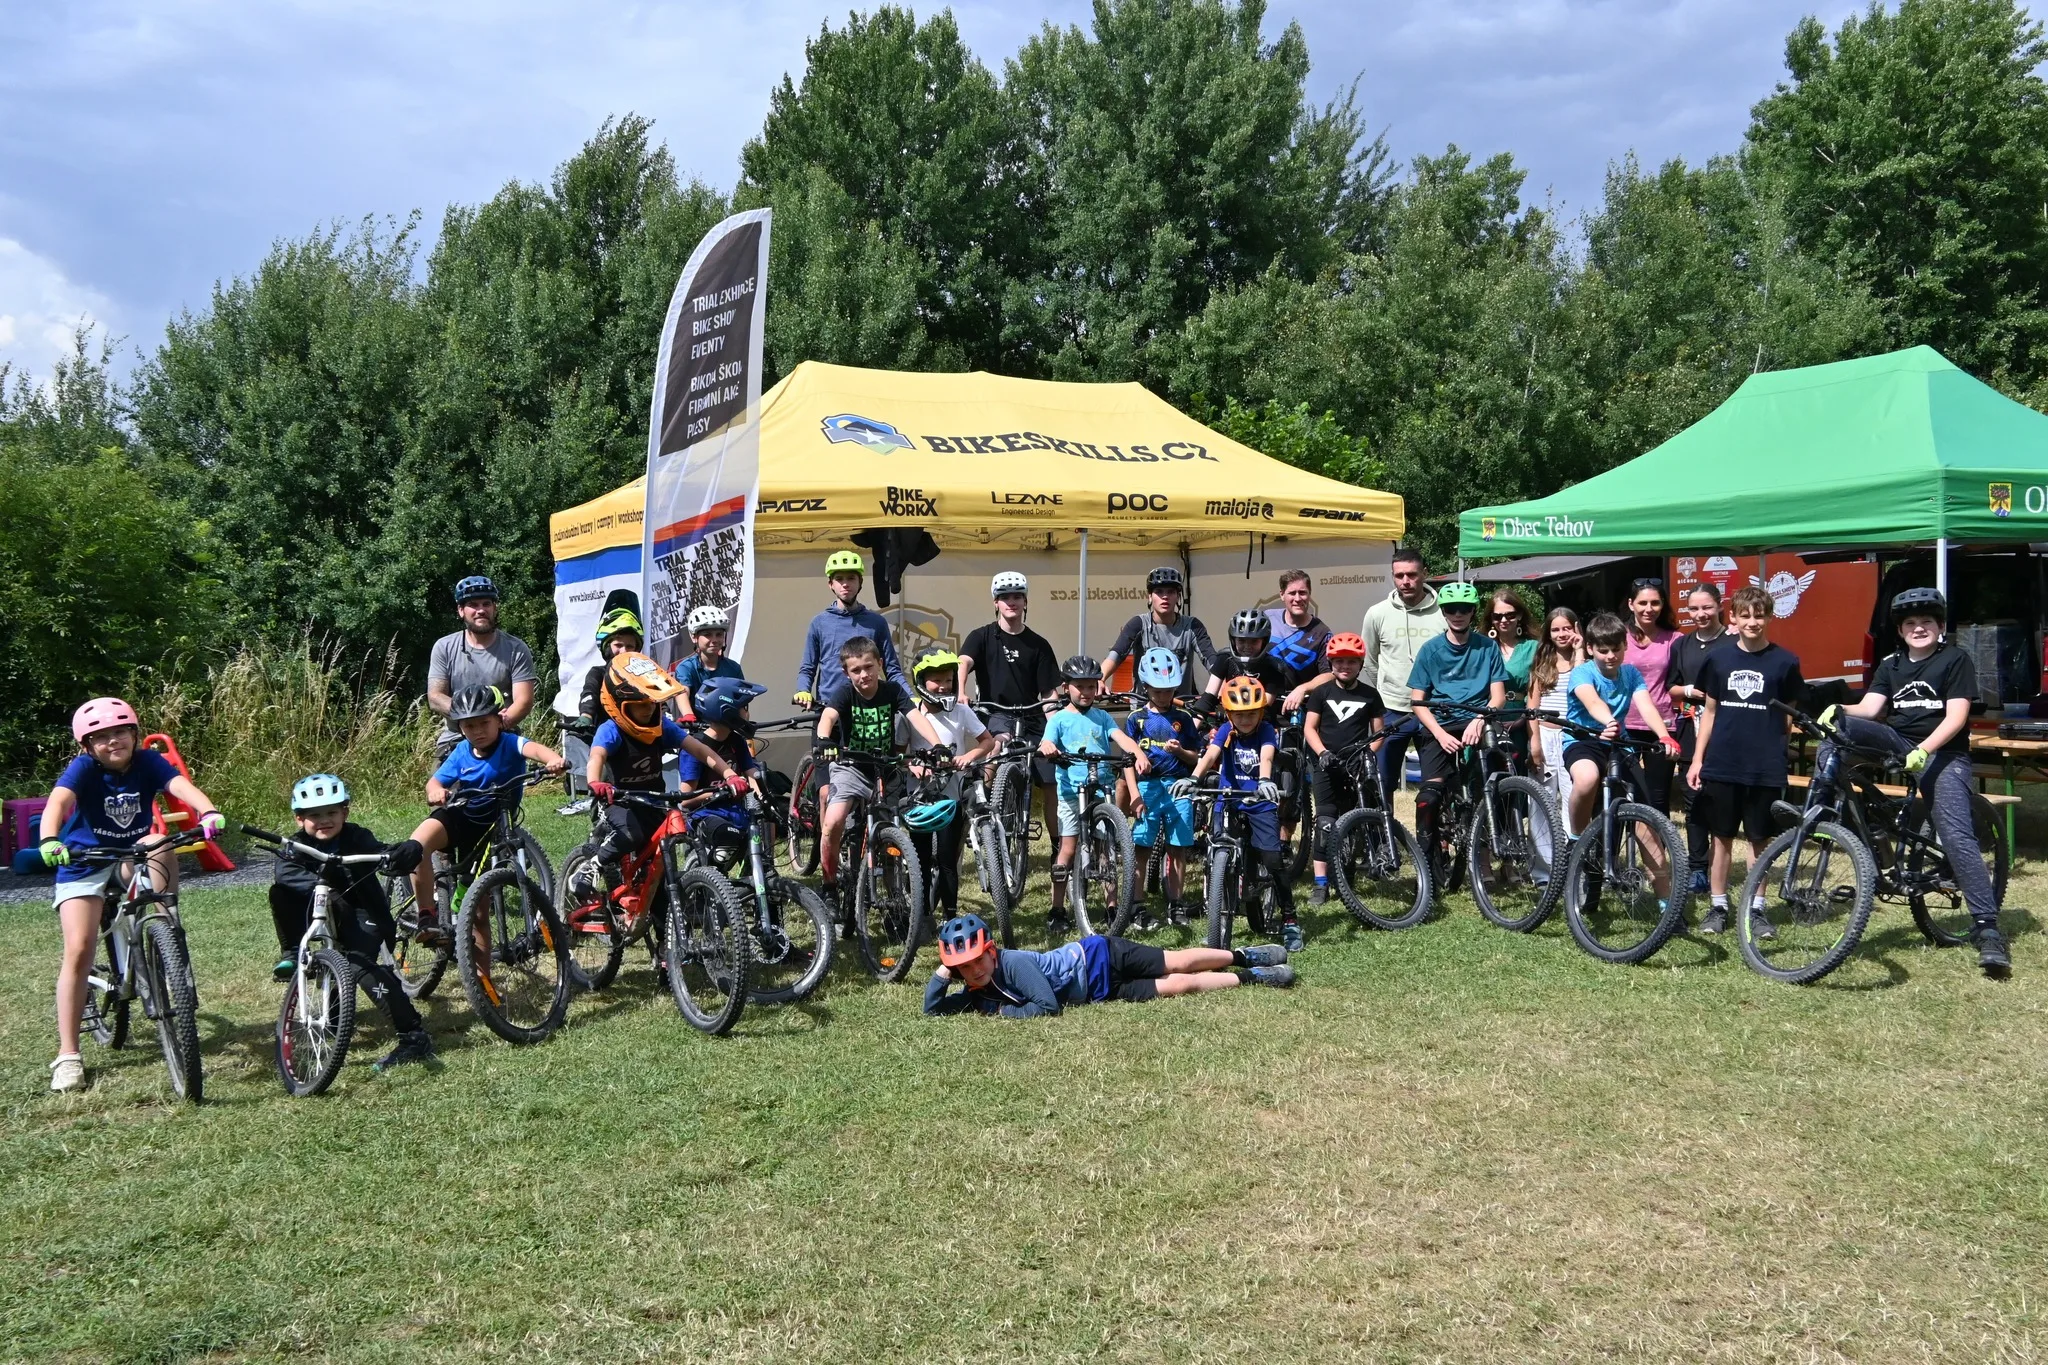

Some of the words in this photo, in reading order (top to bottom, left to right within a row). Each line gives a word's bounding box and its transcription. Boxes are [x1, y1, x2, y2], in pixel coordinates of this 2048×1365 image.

[693, 294, 719, 313] TRIAL
[693, 317, 711, 337] BIKE
[691, 335, 725, 360] EVENTY
[920, 431, 1221, 463] BIKESKILLS.CZ
[886, 486, 923, 502] BIKE
[991, 491, 1063, 506] LEZYNE
[755, 498, 827, 514] UPACAZ
[879, 498, 938, 516] WORKX
[1001, 507, 1034, 516] Engineered
[1035, 508, 1056, 516] Design
[1204, 498, 1260, 519] maloja
[597, 515, 614, 528] campy
[1503, 516, 1542, 538] Obec
[1545, 515, 1595, 537] Tehov
[654, 550, 690, 572] TRIAL
